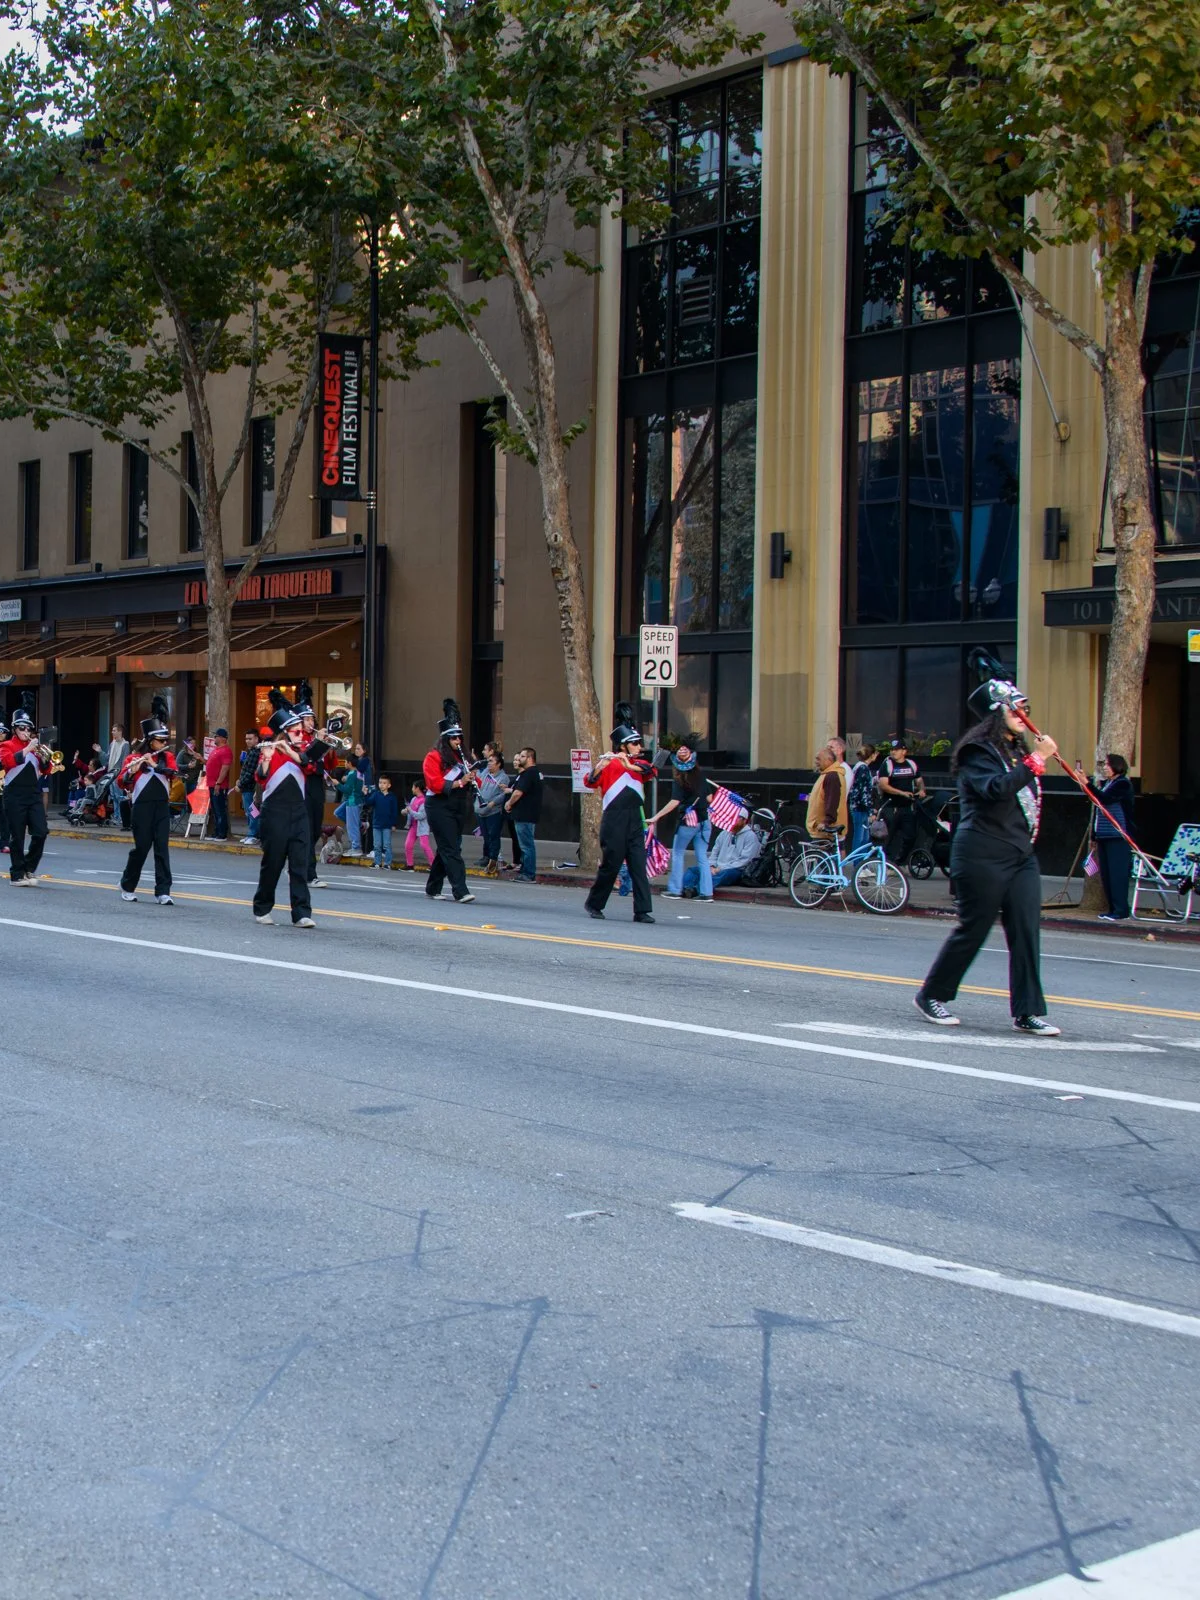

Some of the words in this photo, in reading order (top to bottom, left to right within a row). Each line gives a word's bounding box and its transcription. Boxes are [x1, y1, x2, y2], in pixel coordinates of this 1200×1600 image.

[322, 348, 342, 486] CINEQUEST
[343, 370, 358, 441] FESTIVAL
[342, 447, 357, 485] FILM
[264, 568, 332, 599] TAQUERIA
[1072, 602, 1100, 620] 101
[1153, 596, 1200, 617] ANT
[644, 631, 674, 641] SPEED
[647, 645, 670, 655] LIMIT
[644, 659, 672, 680] 20
